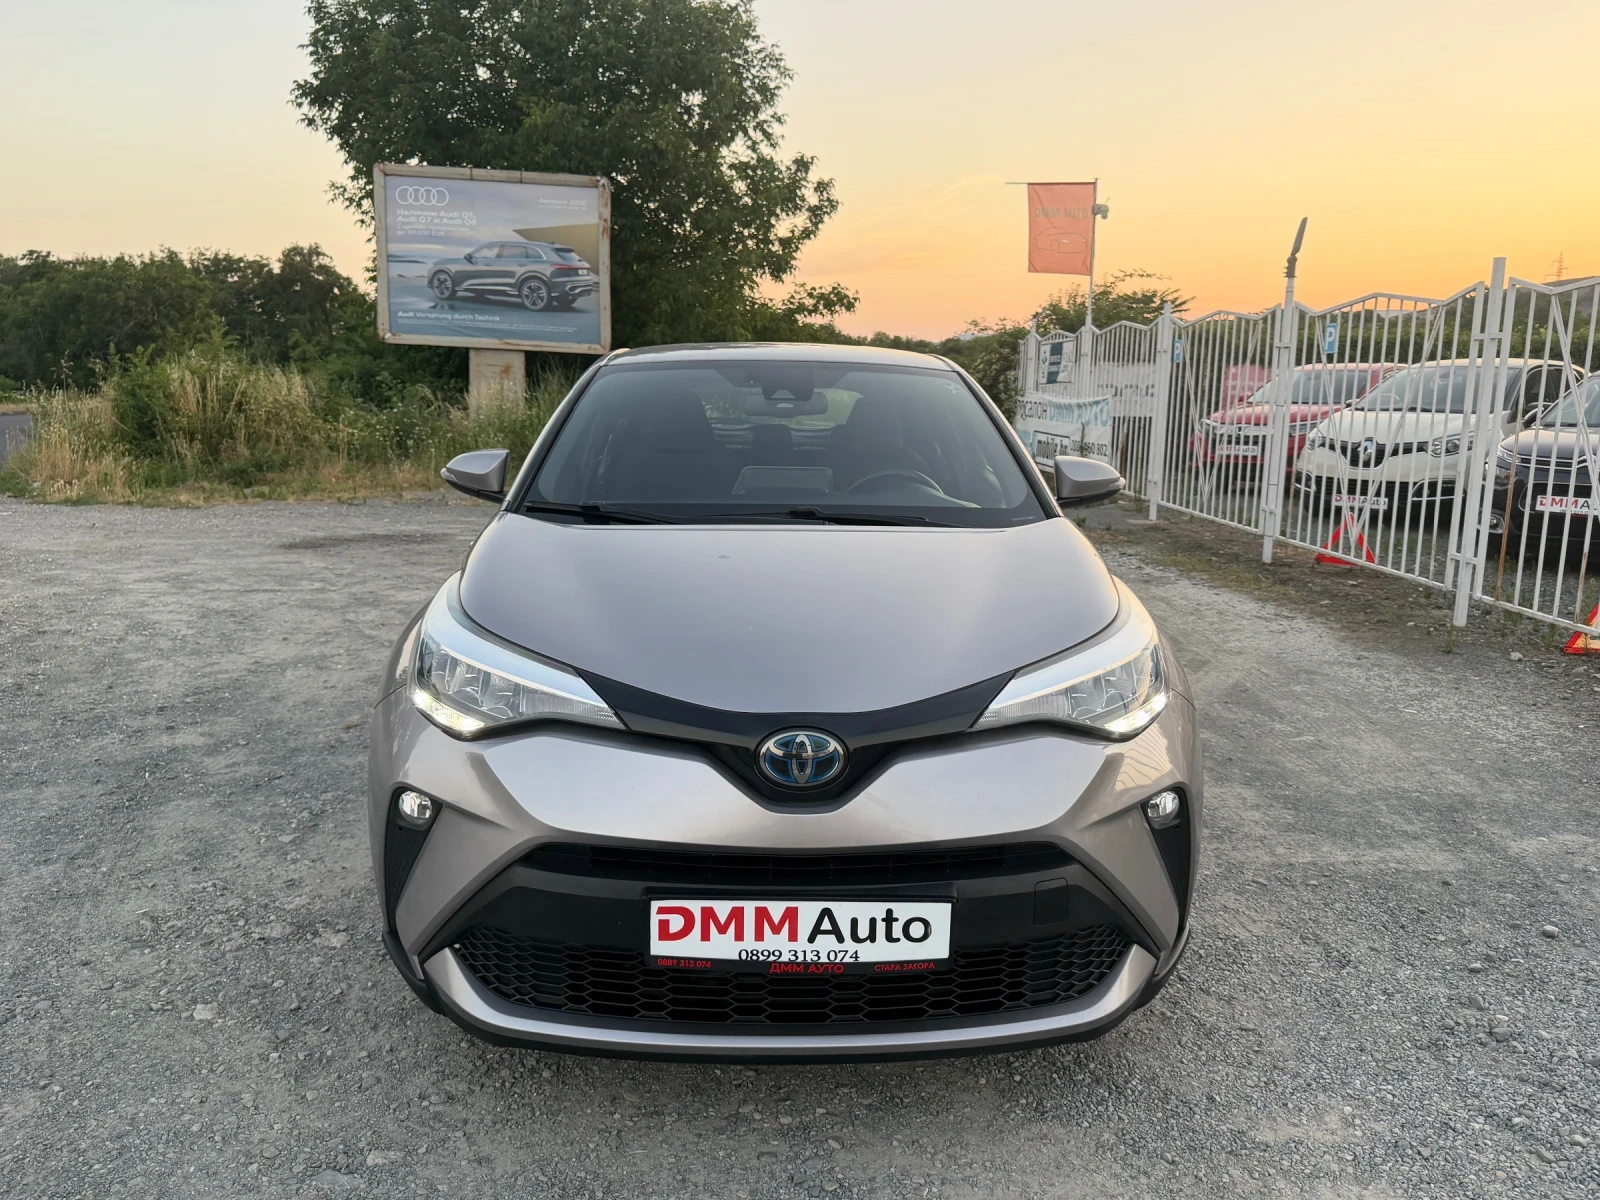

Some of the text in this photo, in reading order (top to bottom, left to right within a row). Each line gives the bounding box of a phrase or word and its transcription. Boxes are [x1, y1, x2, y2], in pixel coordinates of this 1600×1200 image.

[440, 210, 460, 218] Audi
[1063, 207, 1088, 219] AUTO
[416, 312, 452, 320] Vorsprung
[1325, 327, 1335, 350] P
[656, 906, 932, 944] DMM Auto
[738, 949, 860, 962] 0899 313 074
[657, 958, 712, 969] 0889 313 074
[769, 963, 845, 974] ДММ АУТО
[874, 962, 935, 972] СТАРА ЗАГОРА
